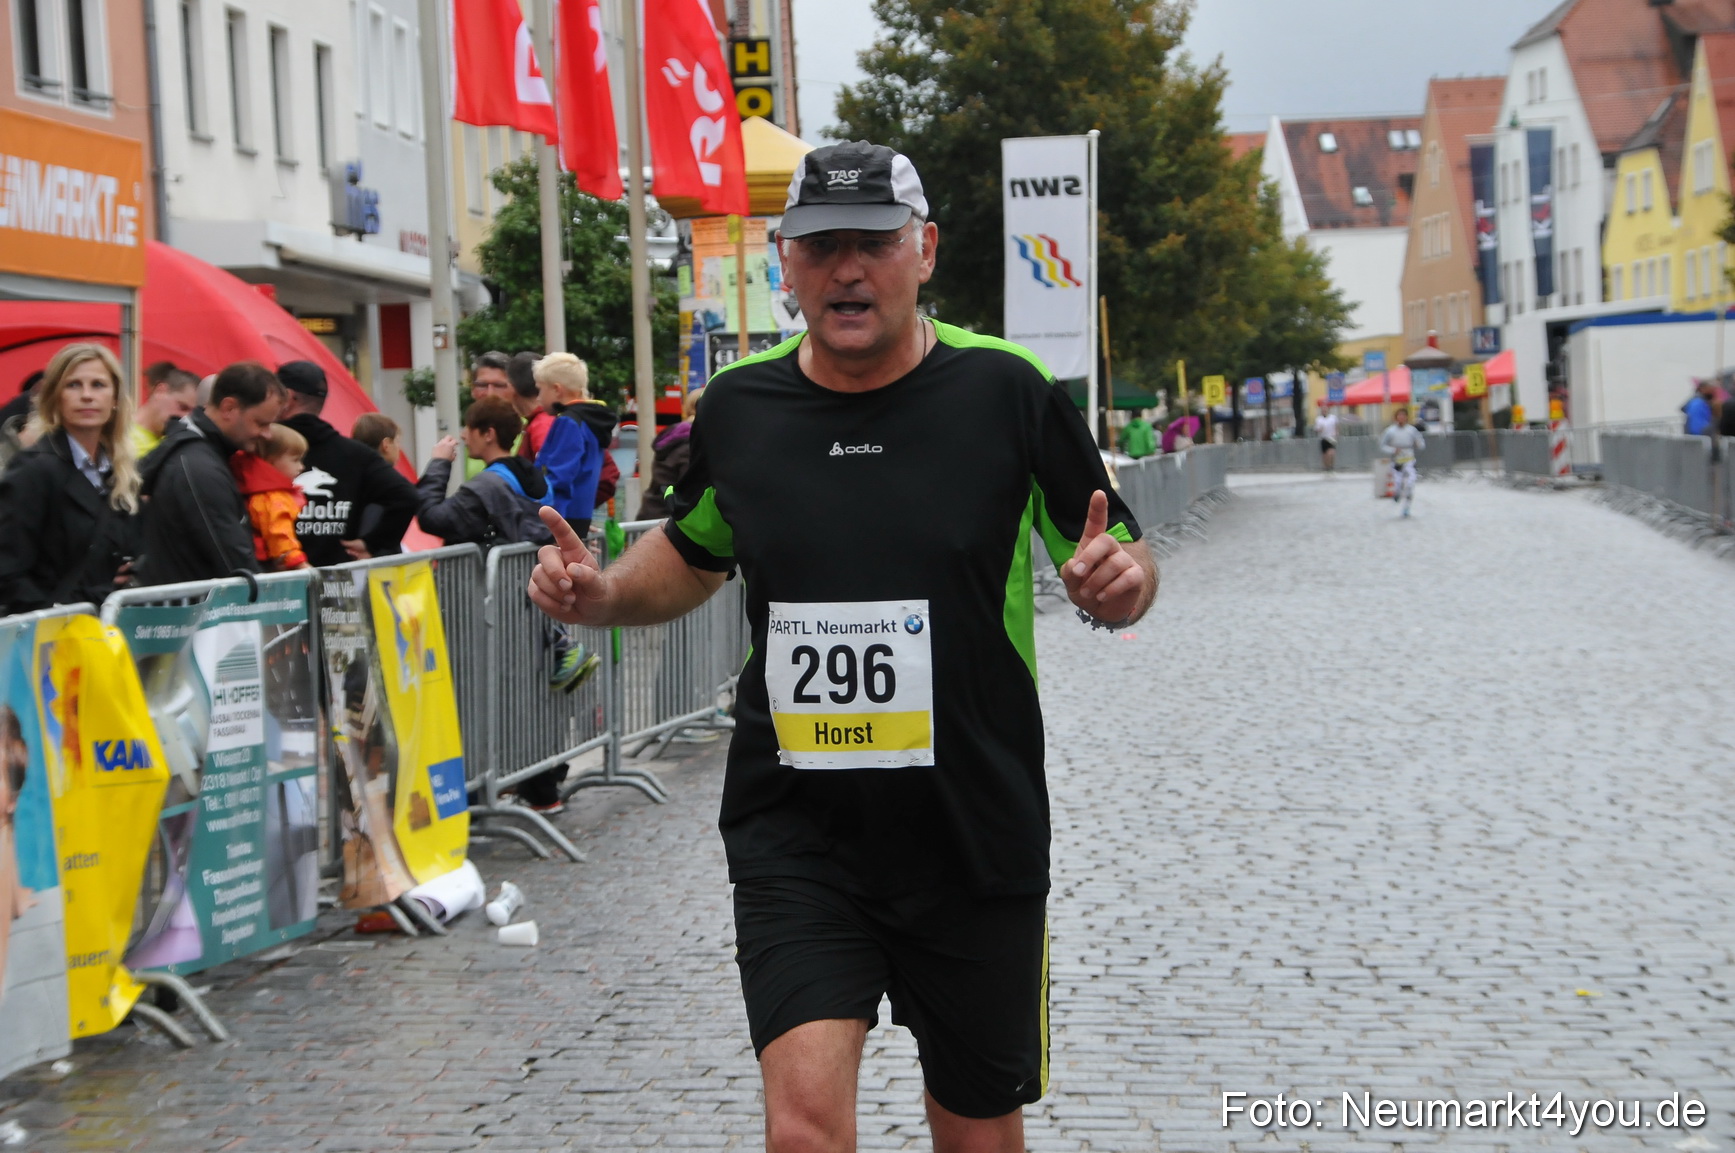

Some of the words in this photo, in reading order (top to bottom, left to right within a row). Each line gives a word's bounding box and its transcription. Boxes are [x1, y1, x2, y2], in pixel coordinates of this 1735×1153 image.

[827, 169, 859, 180] TAO
[845, 443, 883, 454] odlo
[295, 521, 346, 535] SPORTS
[770, 619, 812, 635] PARTL
[817, 619, 898, 635] Neumarkt
[791, 644, 897, 704] 296
[815, 722, 873, 745] Horst
